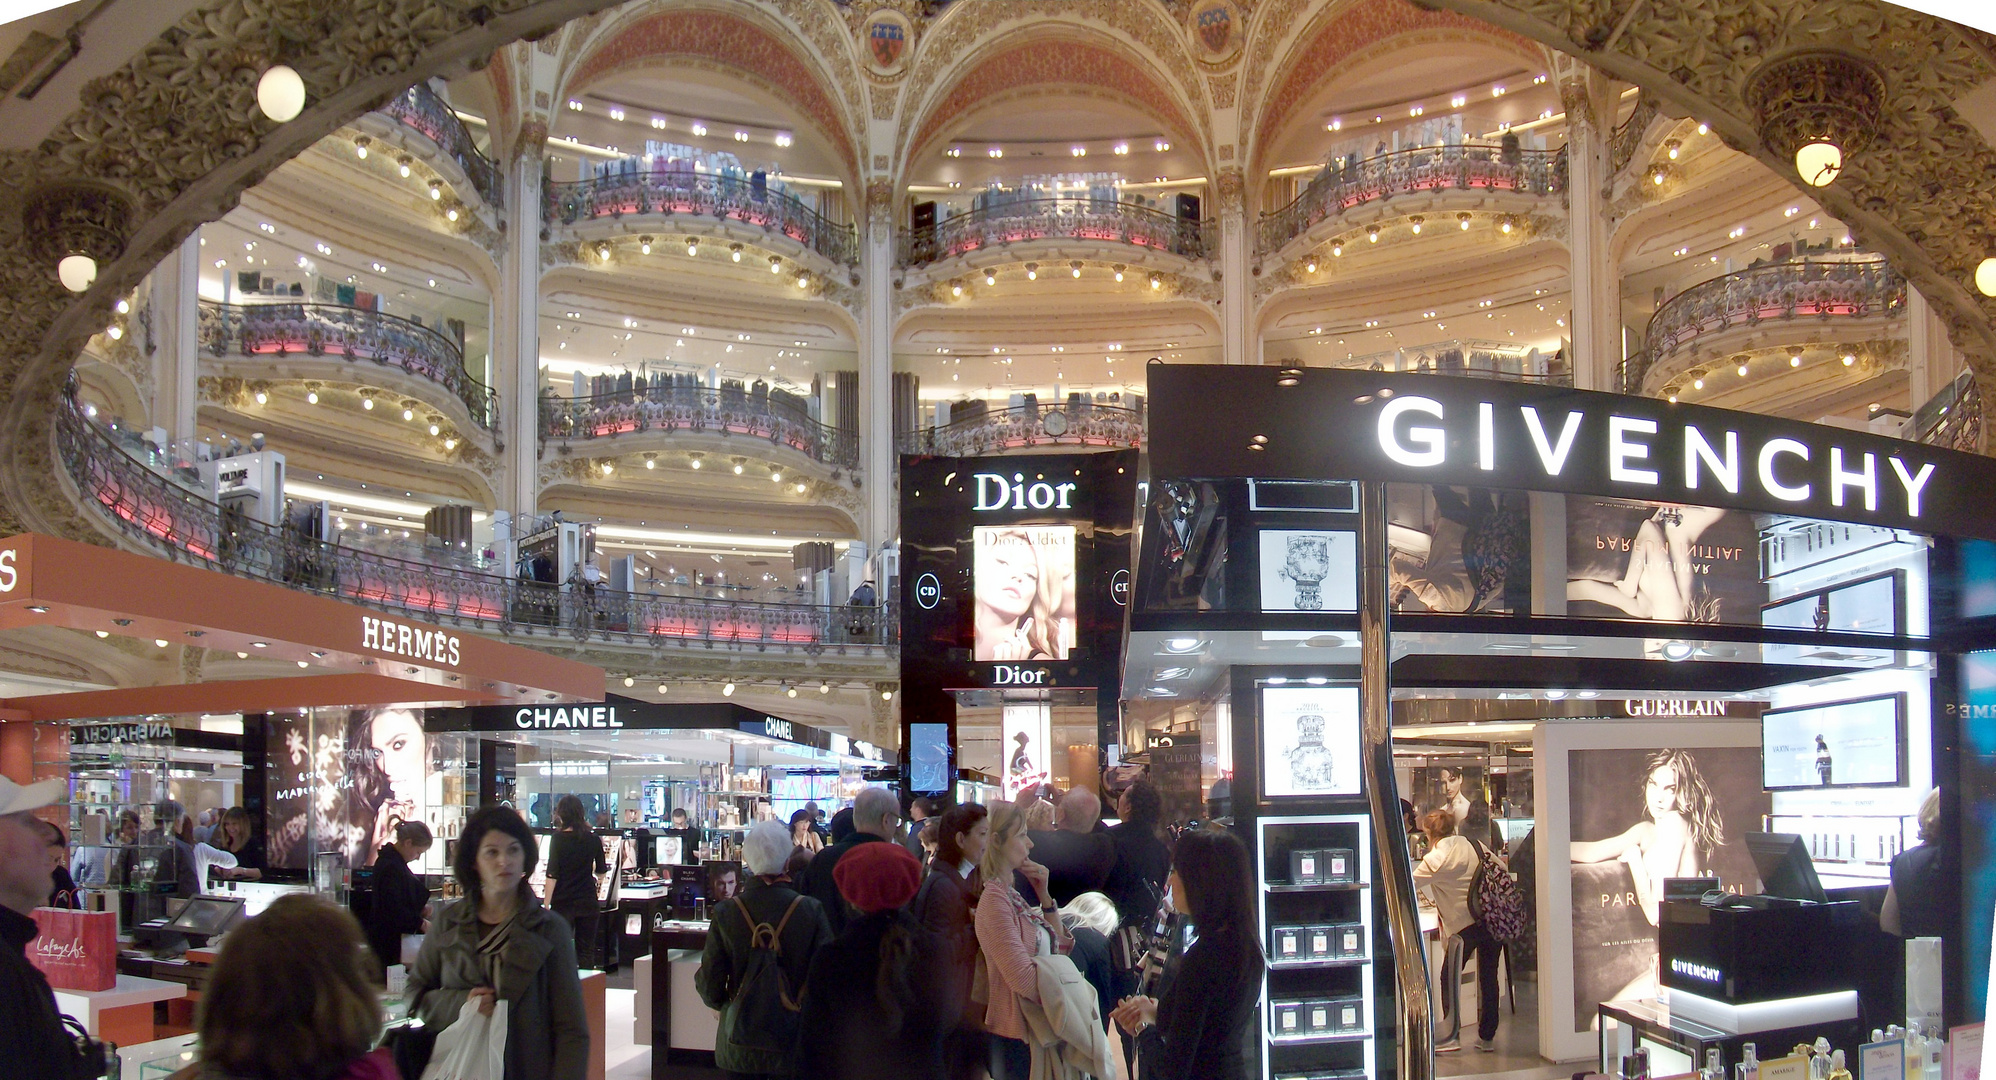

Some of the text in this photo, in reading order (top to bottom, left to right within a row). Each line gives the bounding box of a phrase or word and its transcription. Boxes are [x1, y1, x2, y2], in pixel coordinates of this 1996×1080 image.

[1377, 395, 1937, 518] GIVENCHY
[972, 471, 1077, 511] Dior
[984, 531, 1067, 547] Dior Addict
[362, 616, 460, 666] HERMÈS
[993, 665, 1045, 684] Dior
[515, 706, 624, 728] CHANEL
[1624, 699, 1726, 716] GUERLAIN
[765, 716, 794, 741] CHANEL
[1671, 958, 1720, 982] GIVENCHY
